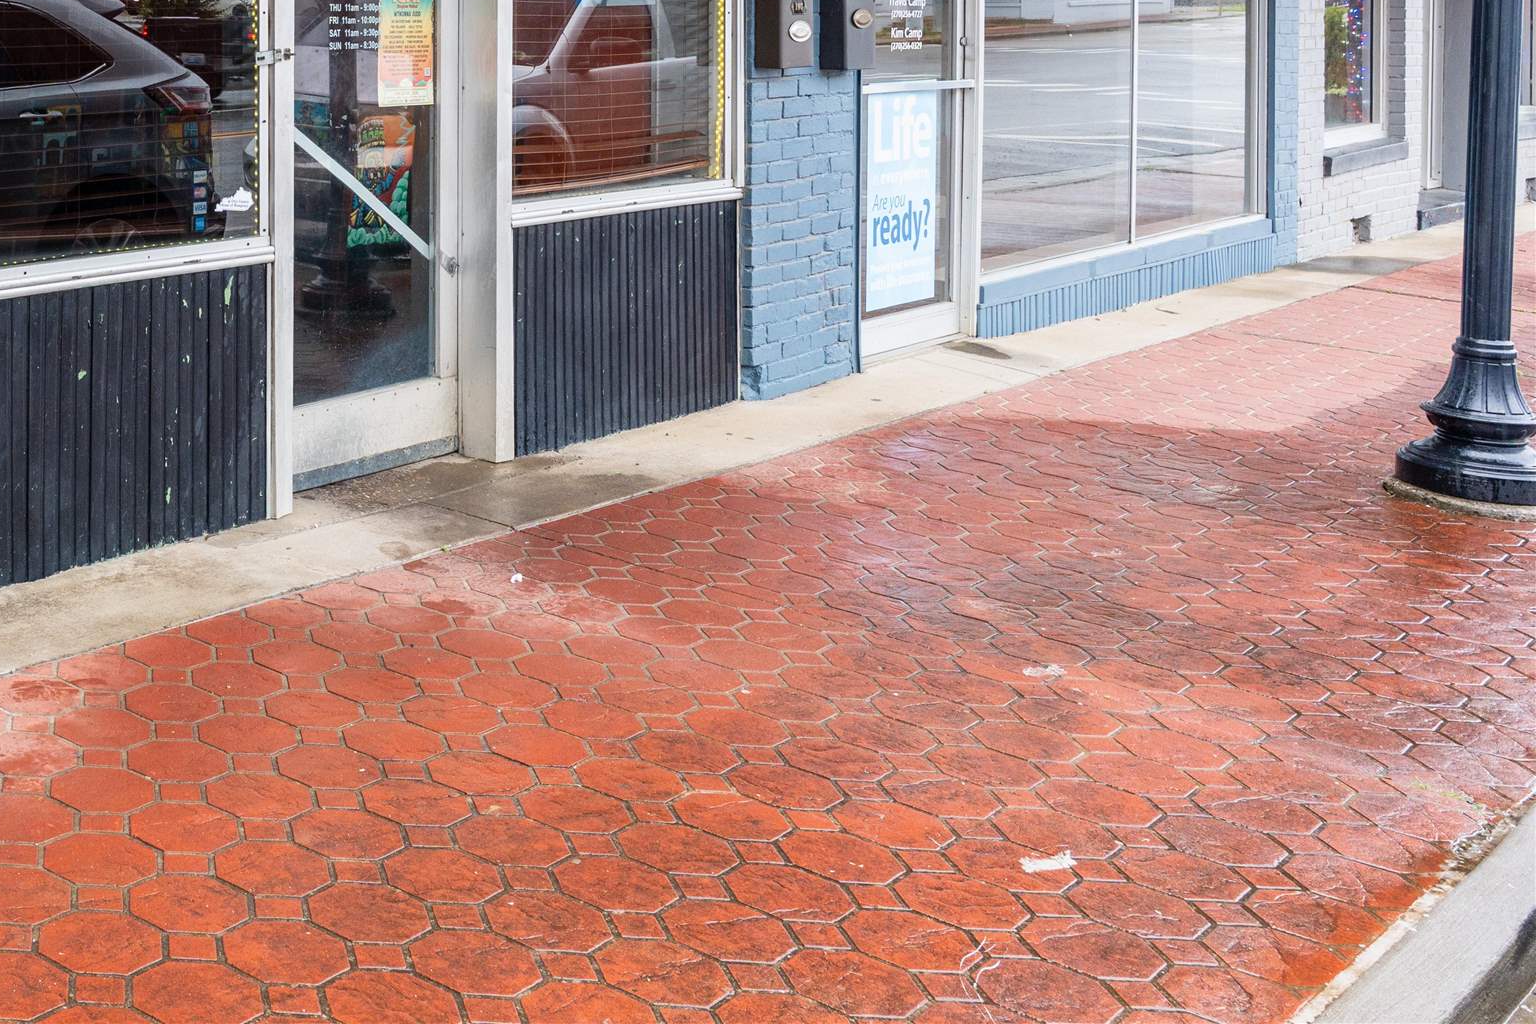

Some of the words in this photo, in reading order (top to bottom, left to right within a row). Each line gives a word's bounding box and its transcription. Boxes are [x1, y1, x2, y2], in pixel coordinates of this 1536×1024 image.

[329, 4, 342, 12] THU
[344, 4, 359, 12] 11am
[364, 4, 380, 13] 9:00p
[361, 17, 380, 26] 10:00p
[890, 27, 904, 39] Kim
[904, 28, 923, 41] Camp
[329, 42, 342, 50] SUN
[344, 42, 359, 50] 11am
[874, 95, 931, 164] Life
[872, 193, 888, 212] Are
[889, 192, 906, 214] you
[872, 198, 931, 251] ready?
